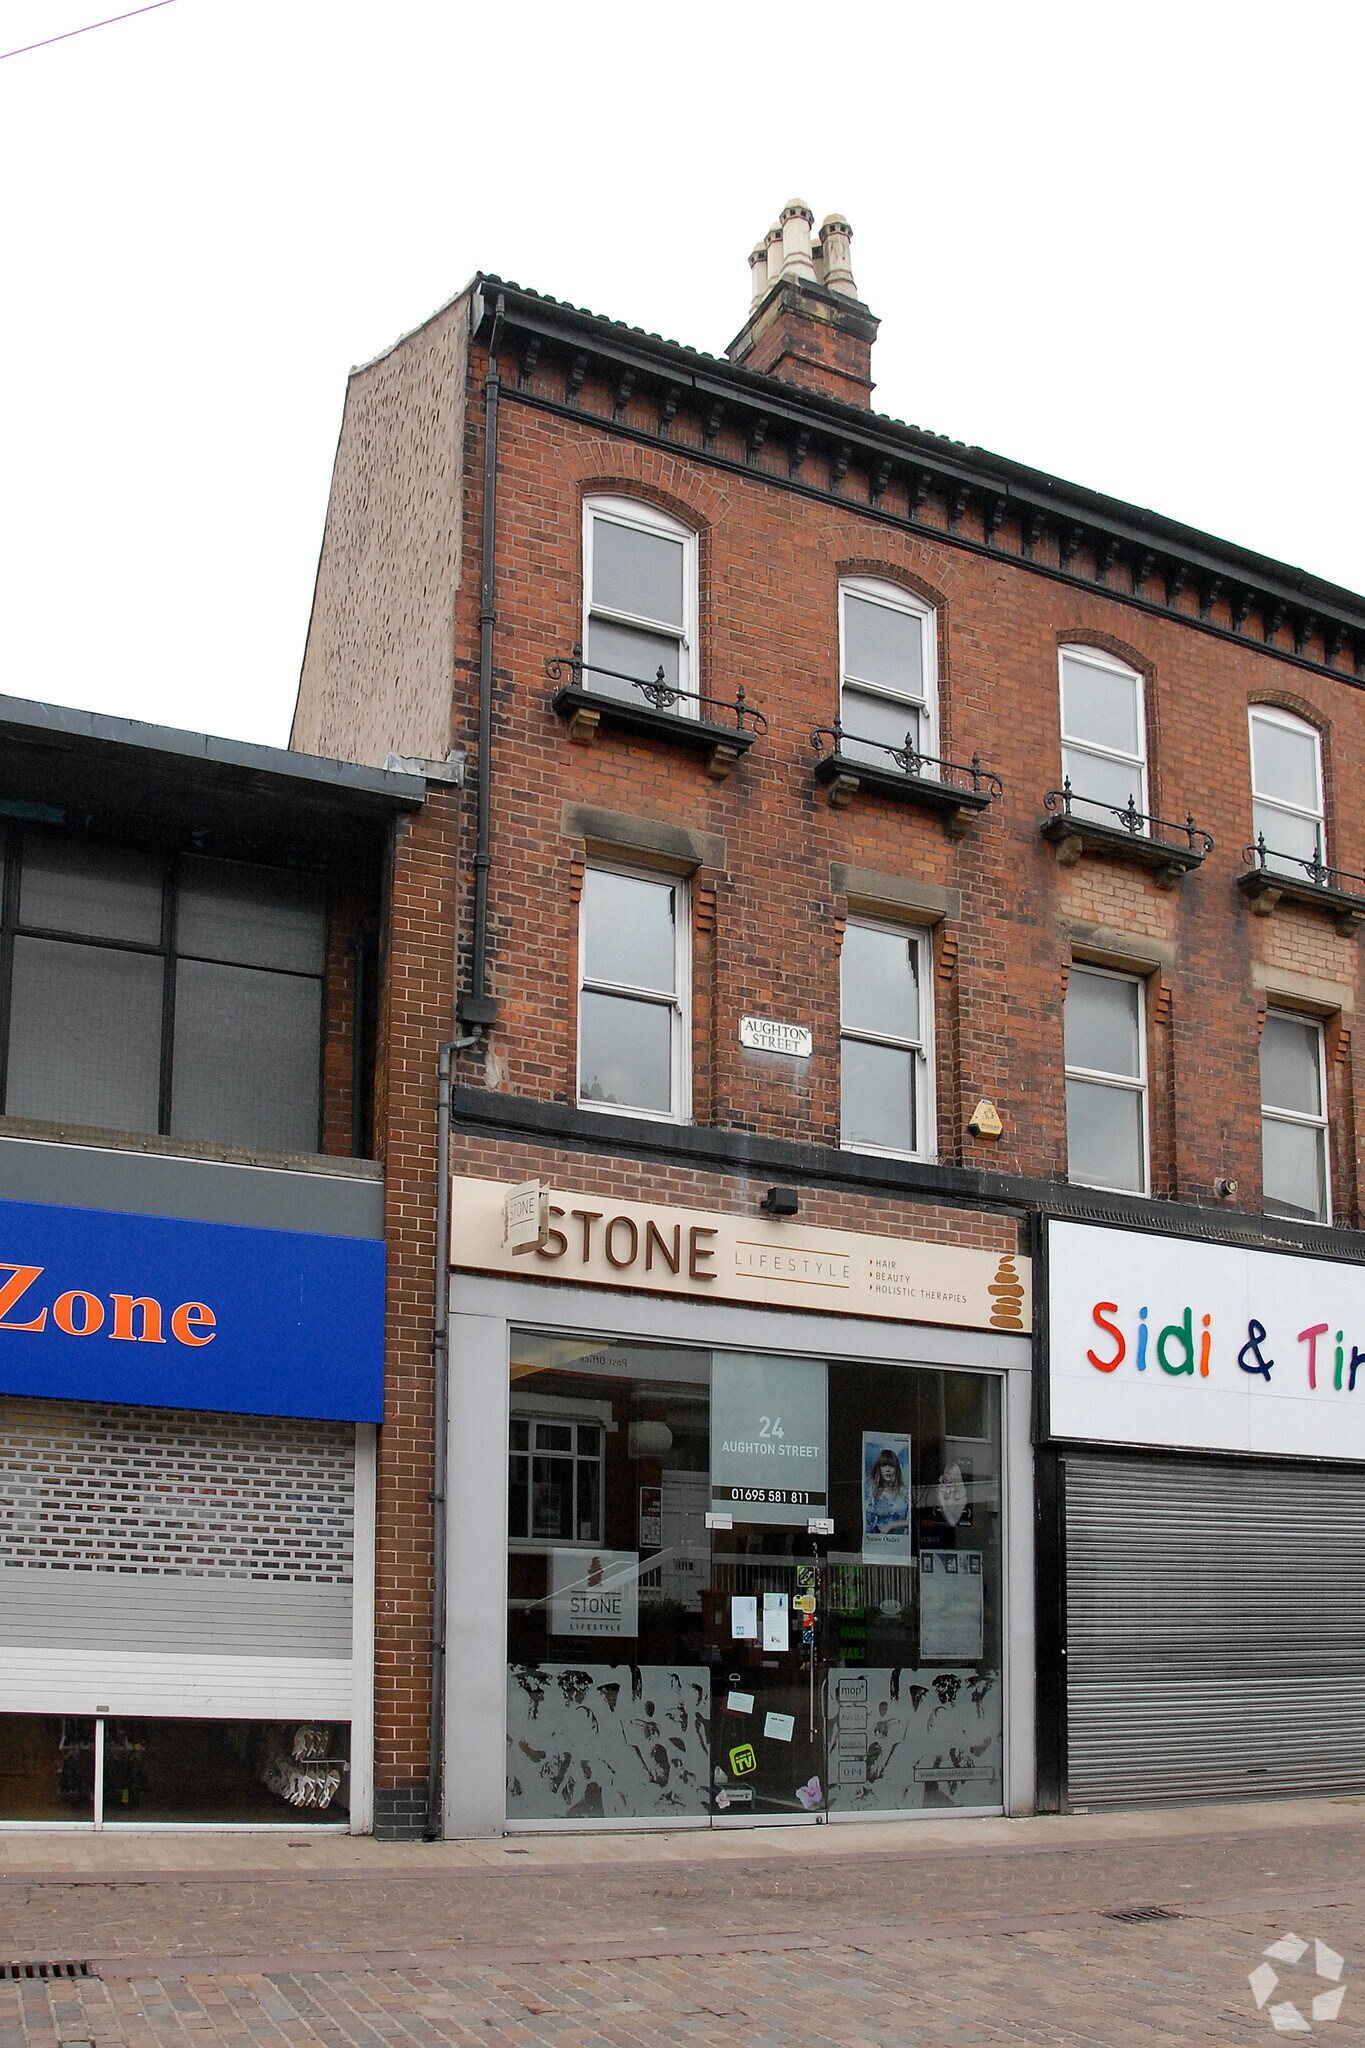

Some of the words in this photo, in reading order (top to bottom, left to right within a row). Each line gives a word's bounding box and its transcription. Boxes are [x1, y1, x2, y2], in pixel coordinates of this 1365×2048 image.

[745, 1020, 807, 1040] AUGHTON
[752, 1034, 800, 1052] STREET
[510, 1198, 535, 1220] STONE
[735, 1252, 850, 1278] LIFESTYLE
[876, 1259, 897, 1269] HAIR
[876, 1272, 911, 1283] BEAUTY
[876, 1284, 915, 1297] HOLISTIC
[921, 1290, 967, 1304] THERAPIES
[0, 1263, 216, 1346] Zone
[1087, 1301, 1212, 1377] Sidi
[1238, 1319, 1274, 1381] &
[759, 1416, 785, 1439] 24
[722, 1441, 775, 1455] AUGHTON
[778, 1445, 820, 1458] STREET
[731, 1488, 765, 1501] 01695
[768, 1491, 786, 1503] 581
[791, 1492, 809, 1504] 811
[571, 1597, 622, 1614] STONE
[570, 1623, 621, 1631] LIFESTYLE
